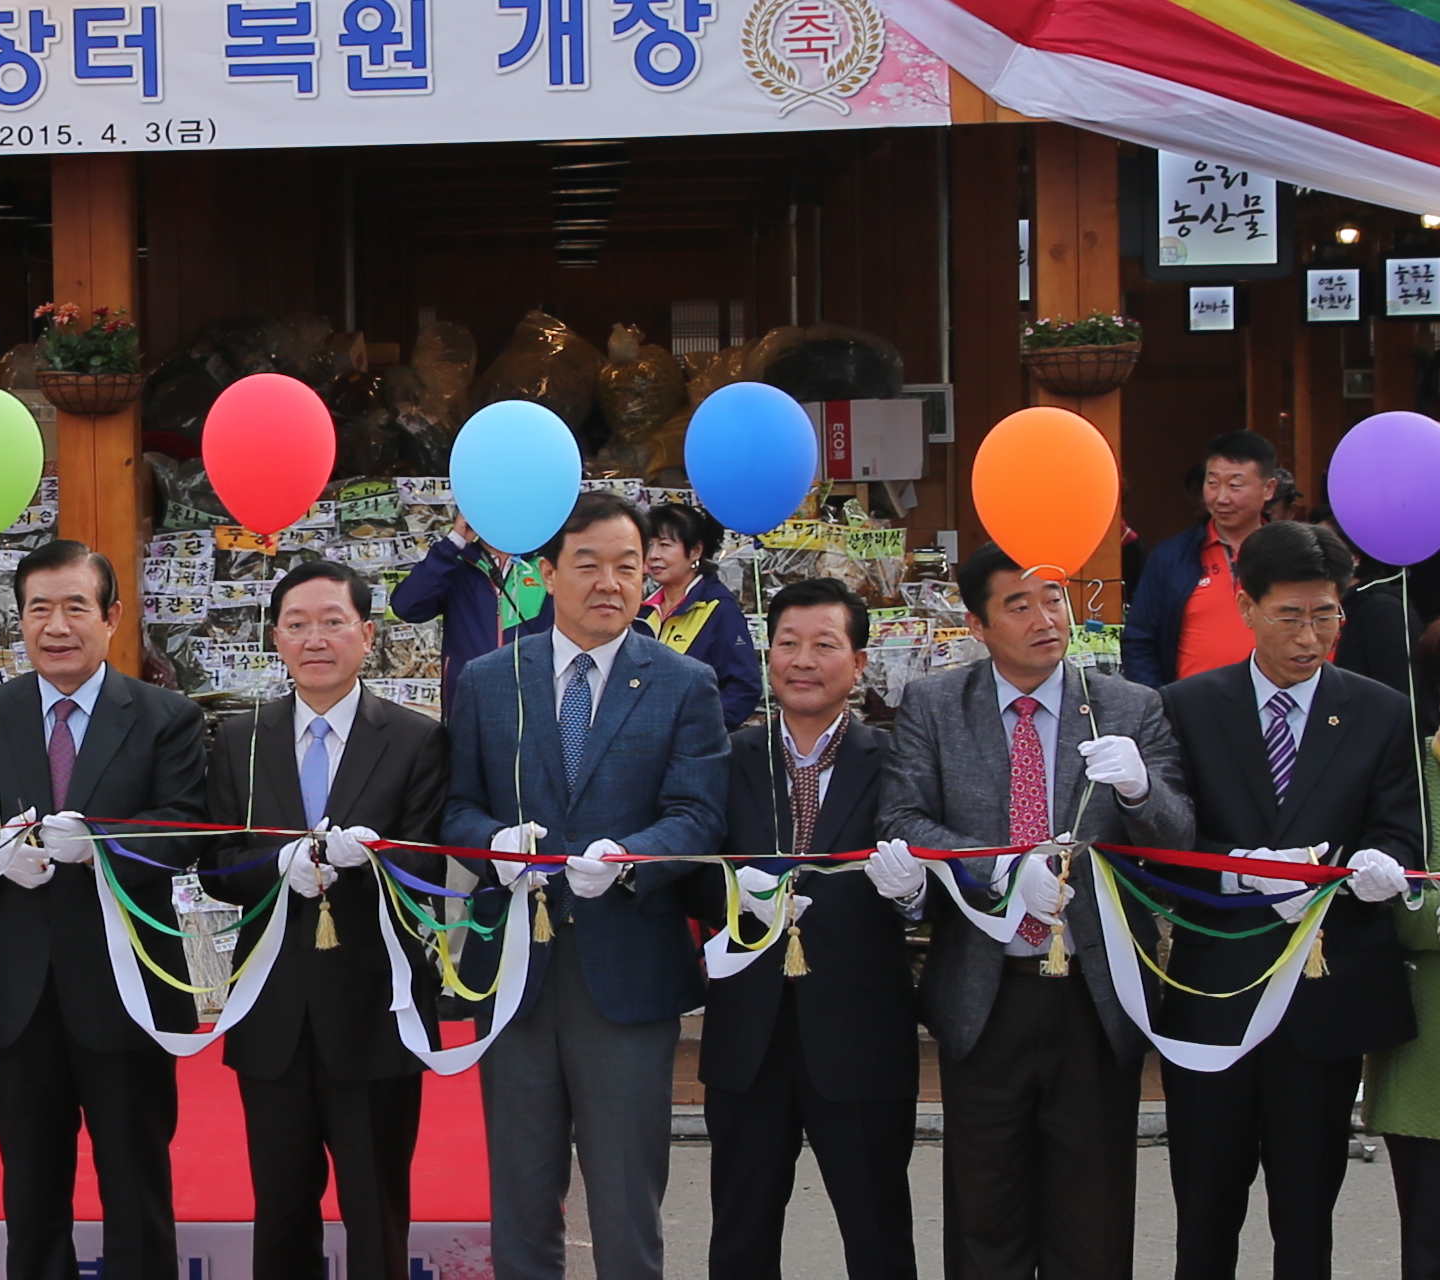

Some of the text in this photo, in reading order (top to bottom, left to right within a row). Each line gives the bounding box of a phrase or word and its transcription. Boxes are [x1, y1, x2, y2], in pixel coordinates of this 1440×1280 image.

[782, 6, 836, 63] 축
[100, 123, 128, 146] 4.
[145, 117, 218, 146] 3(금)
[1186, 160, 1249, 194] 우리
[1167, 193, 1269, 241] 농산물
[1310, 293, 1355, 310] 약초방
